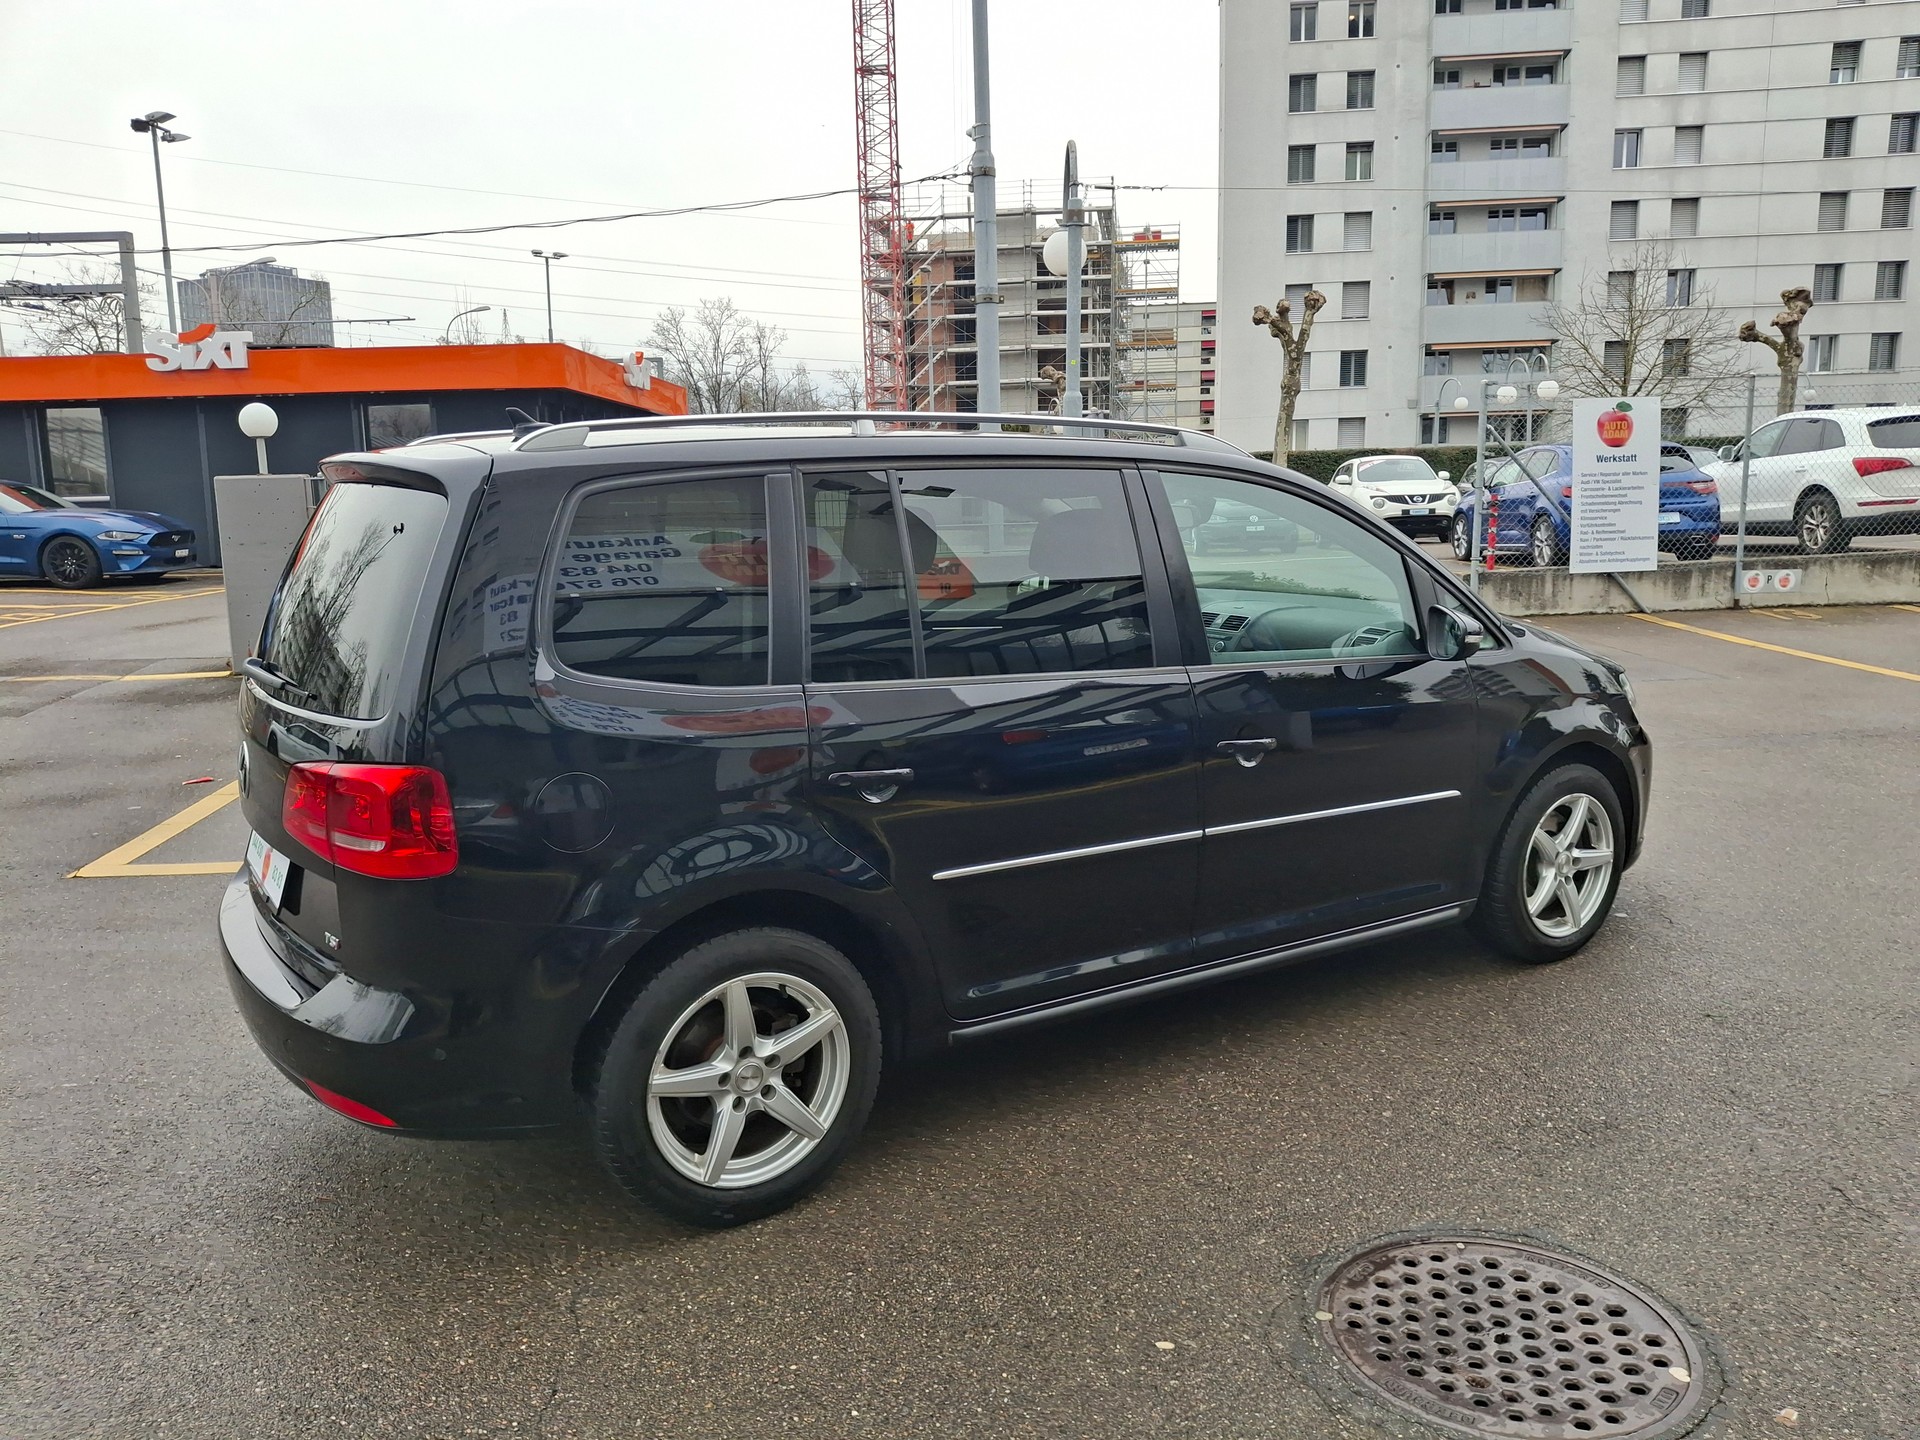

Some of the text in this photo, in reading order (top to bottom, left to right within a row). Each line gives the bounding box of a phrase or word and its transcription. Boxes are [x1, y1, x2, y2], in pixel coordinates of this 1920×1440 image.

[1604, 421, 1627, 430] AUTO
[1603, 430, 1628, 439] ADAM
[1596, 454, 1637, 463] Werkstatt
[1767, 575, 1773, 584] P
